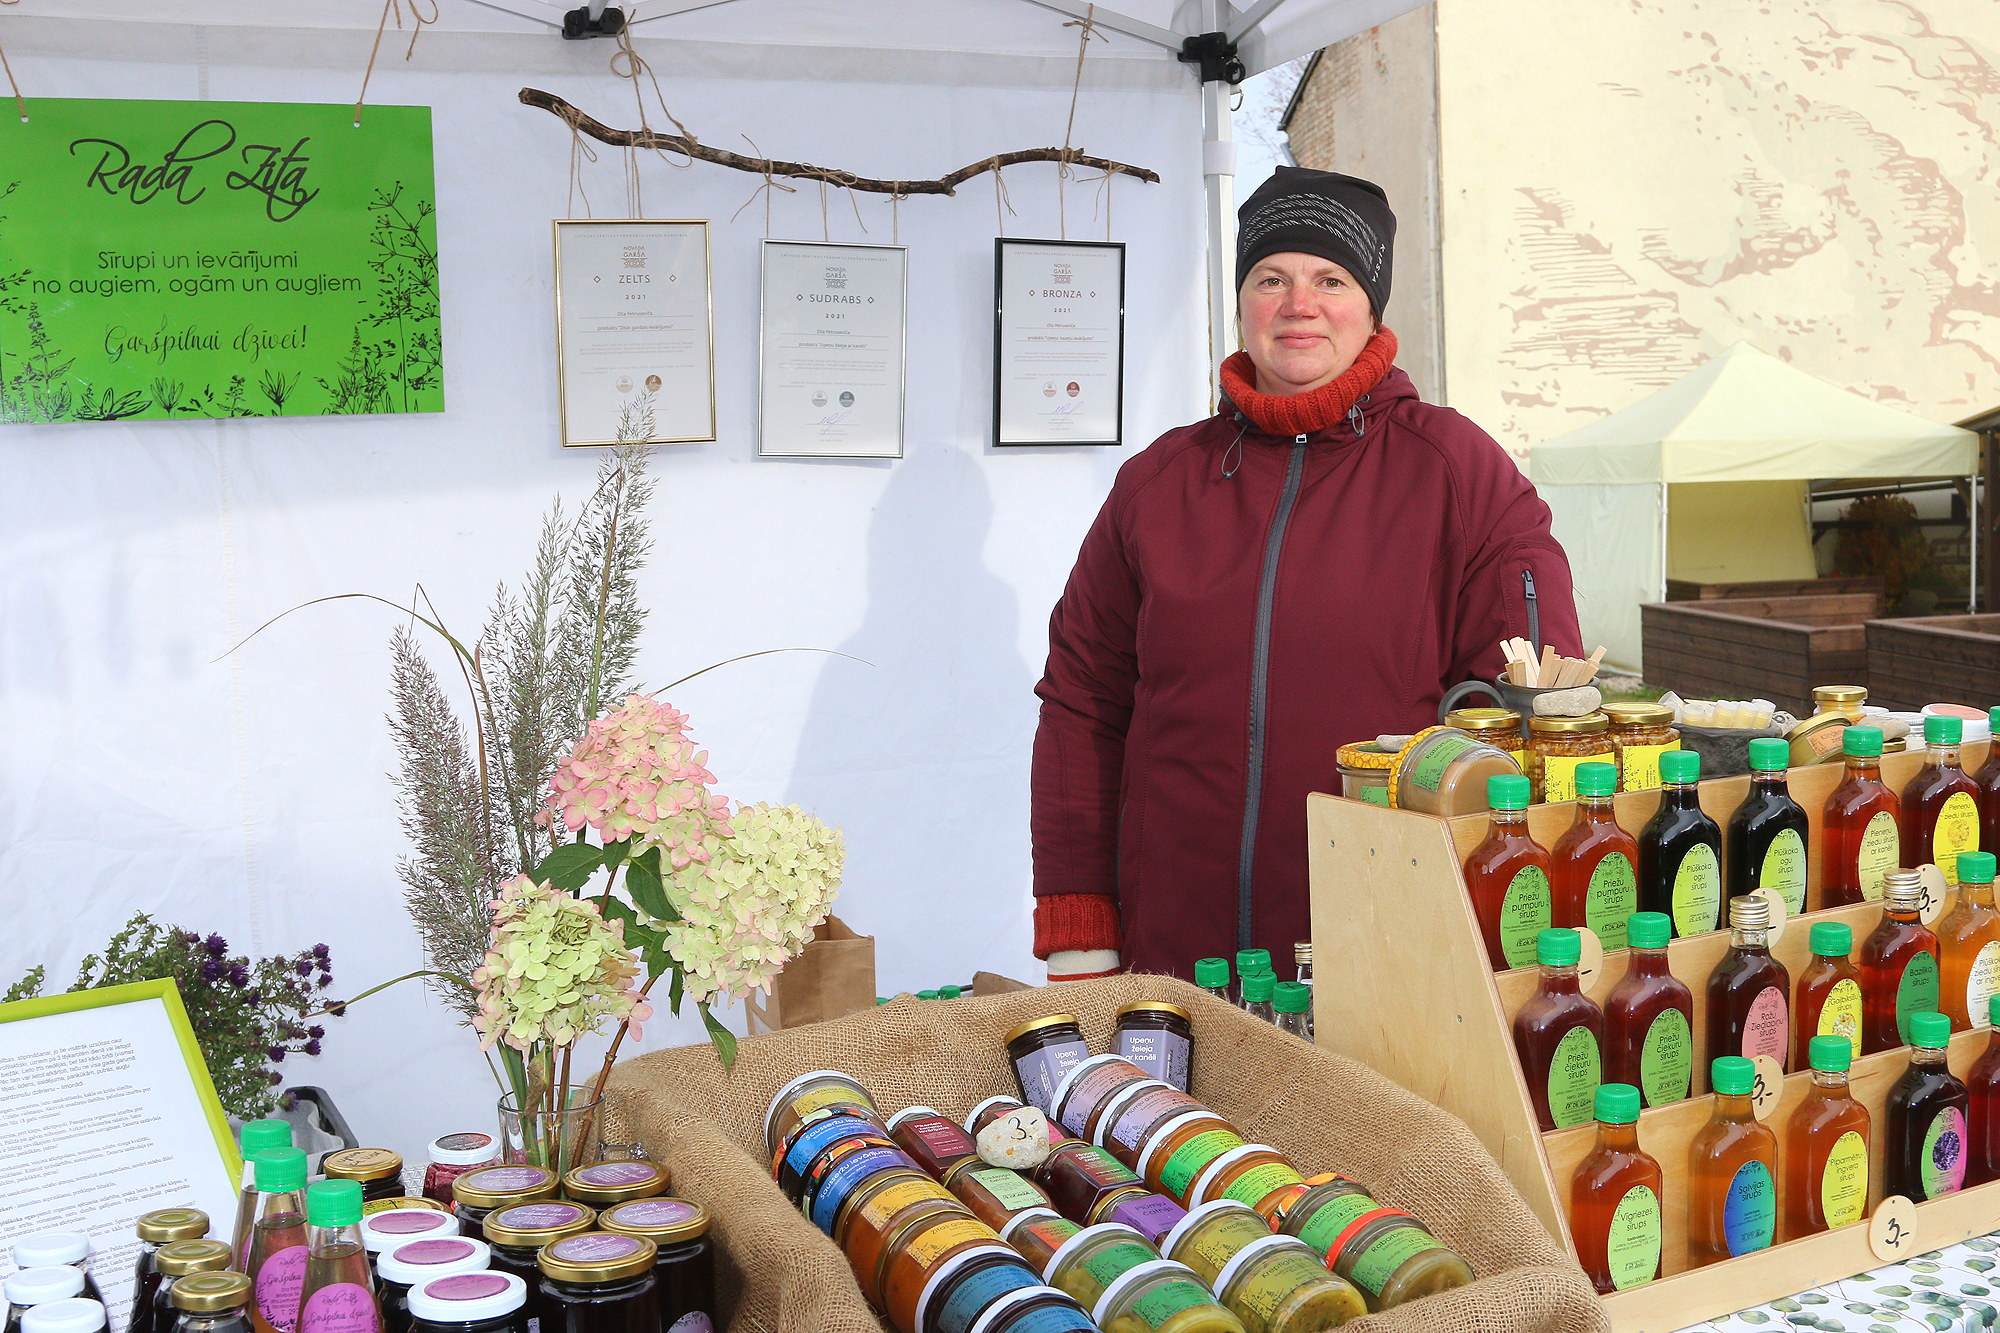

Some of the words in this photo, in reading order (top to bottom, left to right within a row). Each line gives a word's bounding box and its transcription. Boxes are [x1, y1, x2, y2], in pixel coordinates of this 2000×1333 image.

[70, 120, 236, 205] Rada
[227, 136, 319, 222] Zita
[98, 250, 156, 272] Sīrupi
[162, 255, 189, 270] un
[196, 250, 298, 274] ievārījumi
[619, 275, 650, 283] ZELTS
[32, 279, 62, 294] no
[69, 275, 161, 297] augiem,
[168, 274, 235, 296] ogām
[242, 277, 269, 292] un
[275, 274, 361, 296] augļiem
[1043, 289, 1082, 298] BRONZA
[809, 294, 861, 304] SUDRABS
[104, 321, 222, 365] Garšpilnai
[232, 324, 308, 362] dzīvei!
[1780, 858, 1792, 866] ogu
[1687, 863, 1712, 873] Plūškoka
[1778, 866, 1794, 874] sīrups
[1604, 878, 1624, 888] Priežu
[1694, 874, 1706, 882] ogu
[1691, 882, 1707, 891] sīrups
[1518, 892, 1539, 902] Priežu
[1596, 886, 1629, 900] pumpuru
[1604, 895, 1623, 904] sīrups
[1512, 900, 1545, 913] pumpuru
[1519, 910, 1538, 919] sīrups
[1913, 978, 1930, 986] sīrups
[1760, 1011, 1776, 1021] Rožu
[1760, 1028, 1776, 1037] sīrups
[1130, 1037, 1154, 1045] Upeņu
[1660, 1033, 1679, 1043] Priežu
[1657, 1040, 1682, 1054] čiekuru
[1054, 1050, 1078, 1060] Upeņu
[1568, 1051, 1588, 1062] Priežu
[1660, 1050, 1679, 1060] sīrups
[1564, 1060, 1591, 1072] čiekuru
[1568, 1069, 1588, 1079] sīrups
[1008, 1116, 1038, 1140] 3,-
[1742, 1190, 1762, 1201] sīrups
[1135, 1201, 1166, 1211] Plūmju
[1142, 1206, 1173, 1216] čatnijs
[1306, 1201, 1341, 1231] Rabarberu
[1620, 1207, 1653, 1222] Vīgriezes
[1627, 1220, 1647, 1231] sīrups
[1885, 1217, 1910, 1248] 3,-
